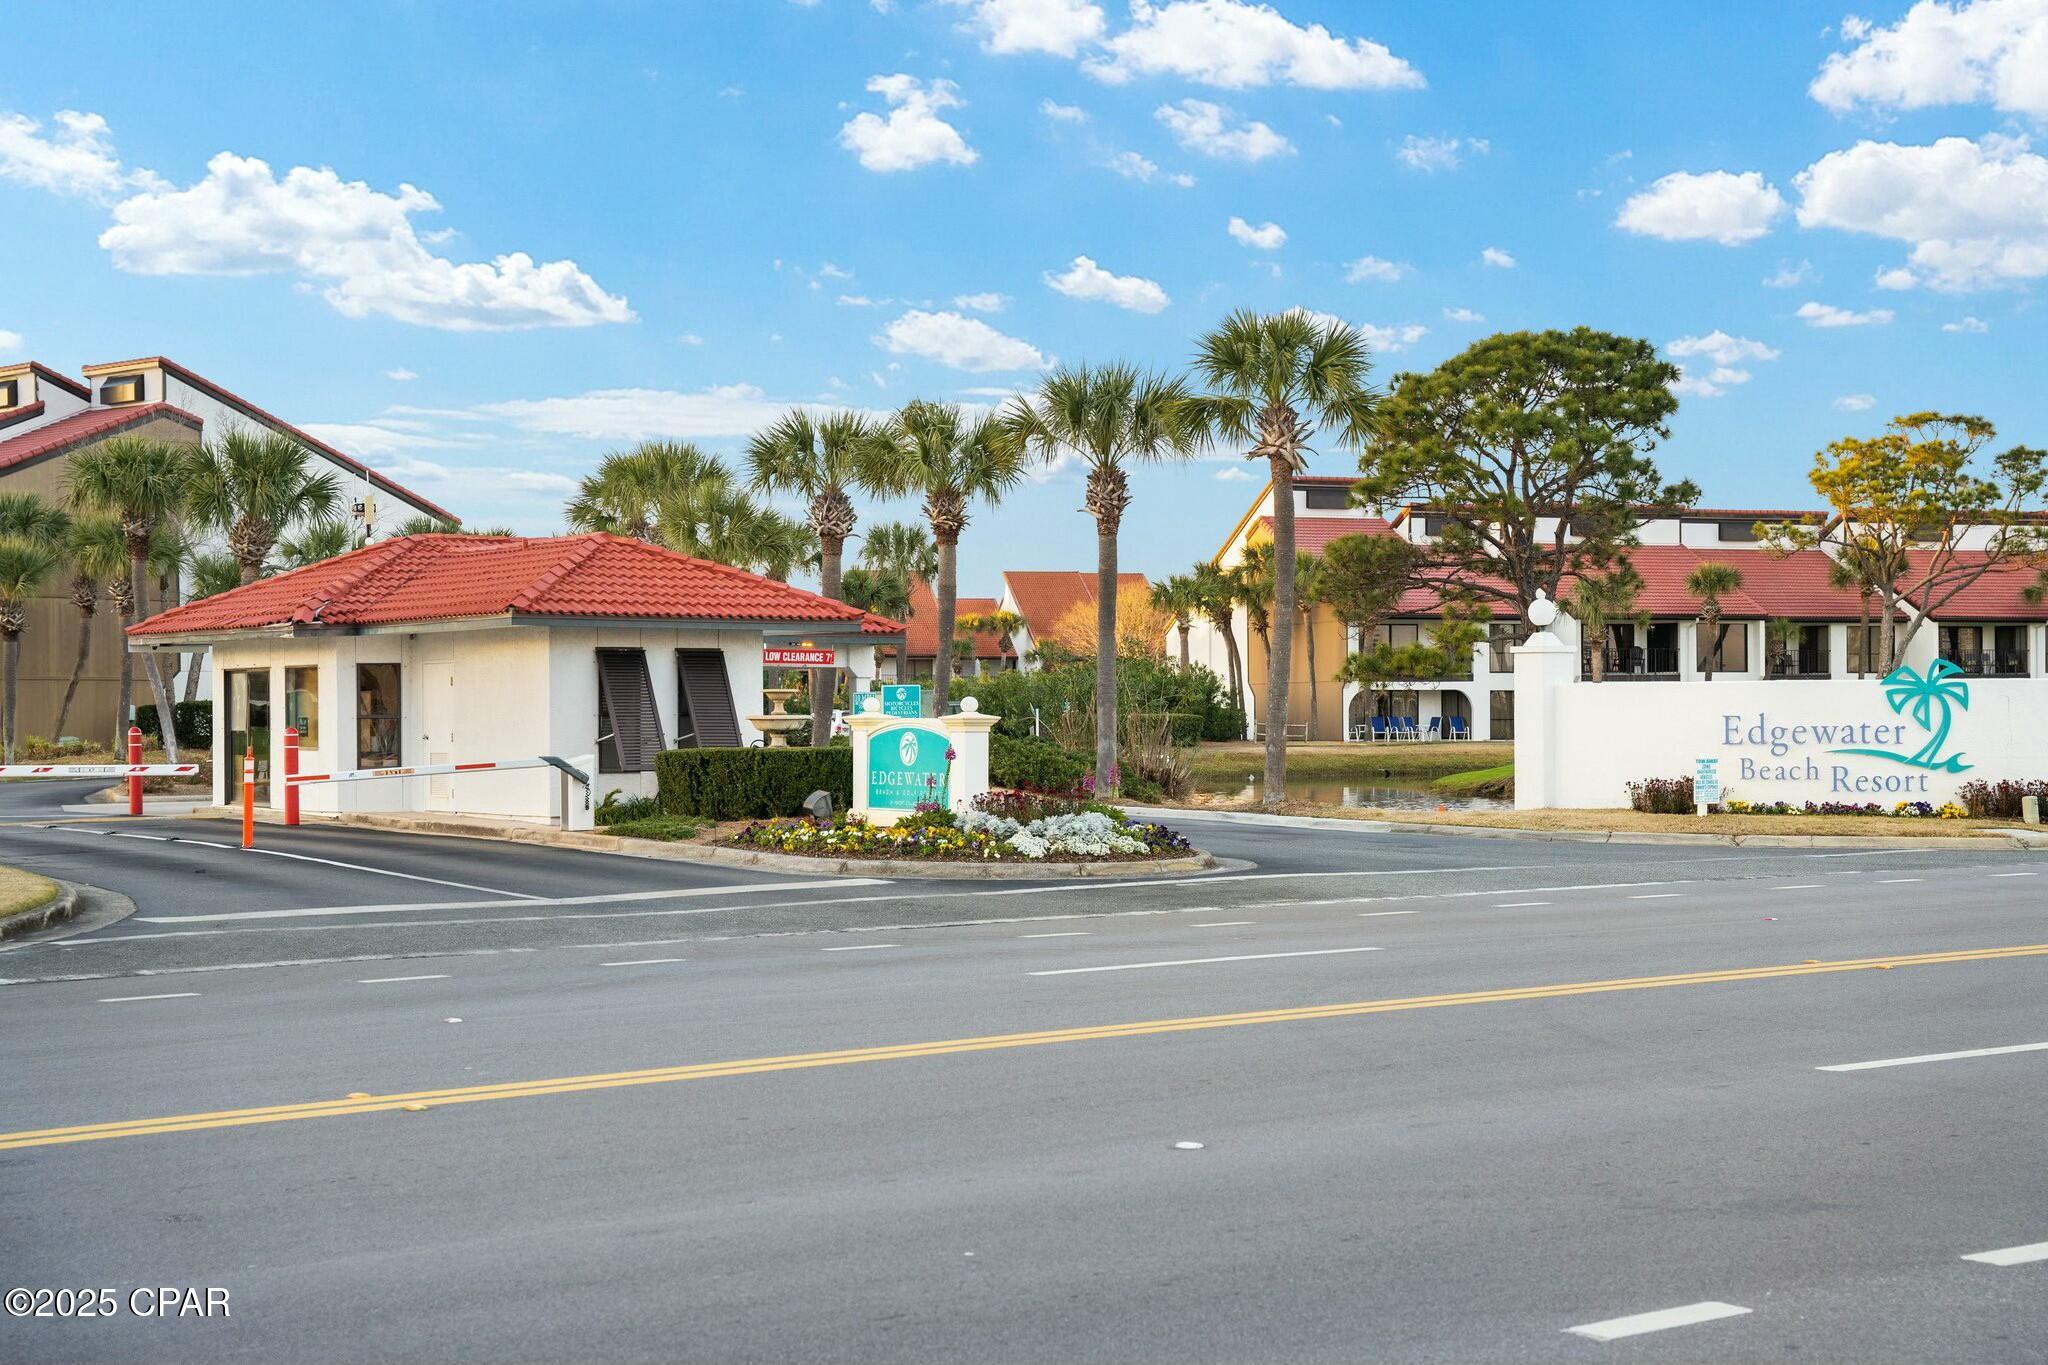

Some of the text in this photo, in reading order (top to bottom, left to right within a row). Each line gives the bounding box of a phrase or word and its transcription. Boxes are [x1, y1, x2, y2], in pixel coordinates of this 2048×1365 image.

[765, 652, 780, 661] LOW
[783, 652, 824, 662] CLEARANCE
[1721, 712, 1906, 757] Edgewater
[1740, 757, 1929, 793] Beach Resort
